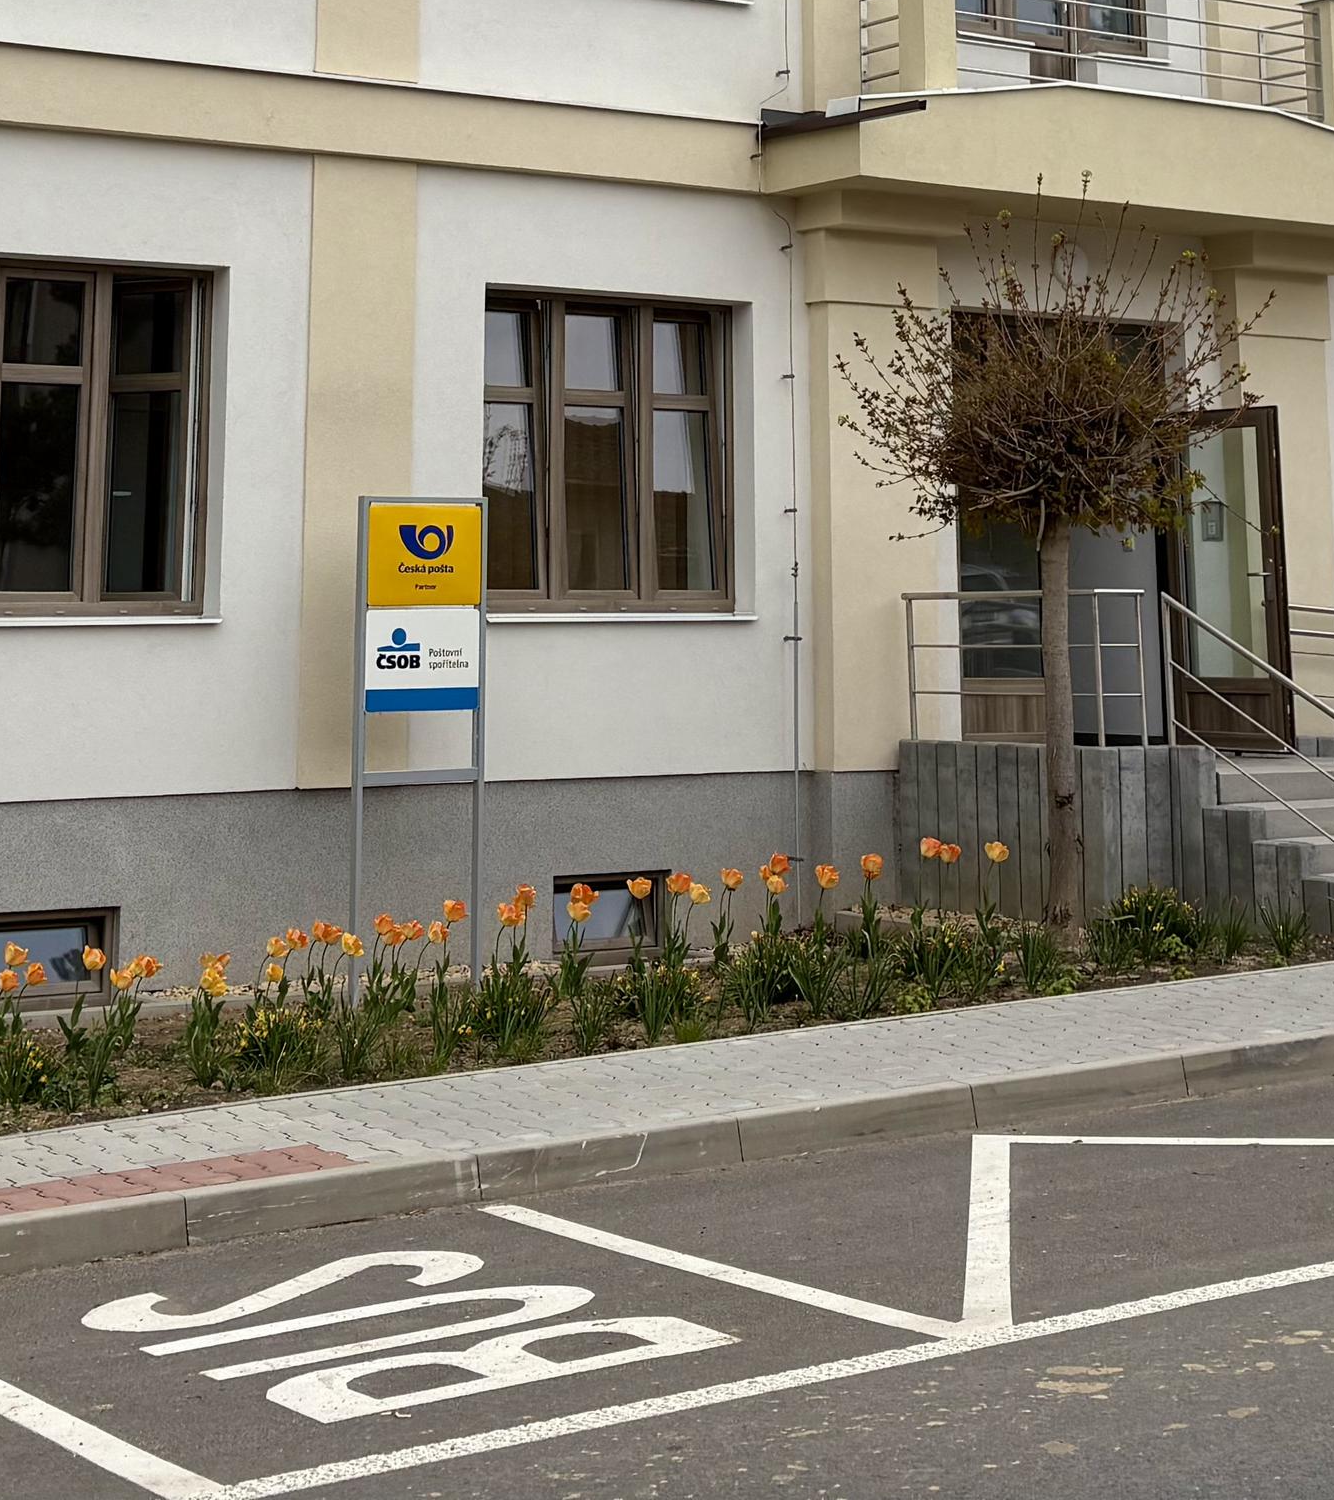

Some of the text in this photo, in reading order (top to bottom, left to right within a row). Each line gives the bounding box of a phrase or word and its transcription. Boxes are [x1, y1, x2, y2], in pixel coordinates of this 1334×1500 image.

[398, 562, 454, 575] Česká pošta
[428, 648, 463, 658] Poštovní
[376, 653, 421, 670] ČSOB
[428, 659, 469, 670] spořitelna
[80, 1250, 742, 1424] BUS
